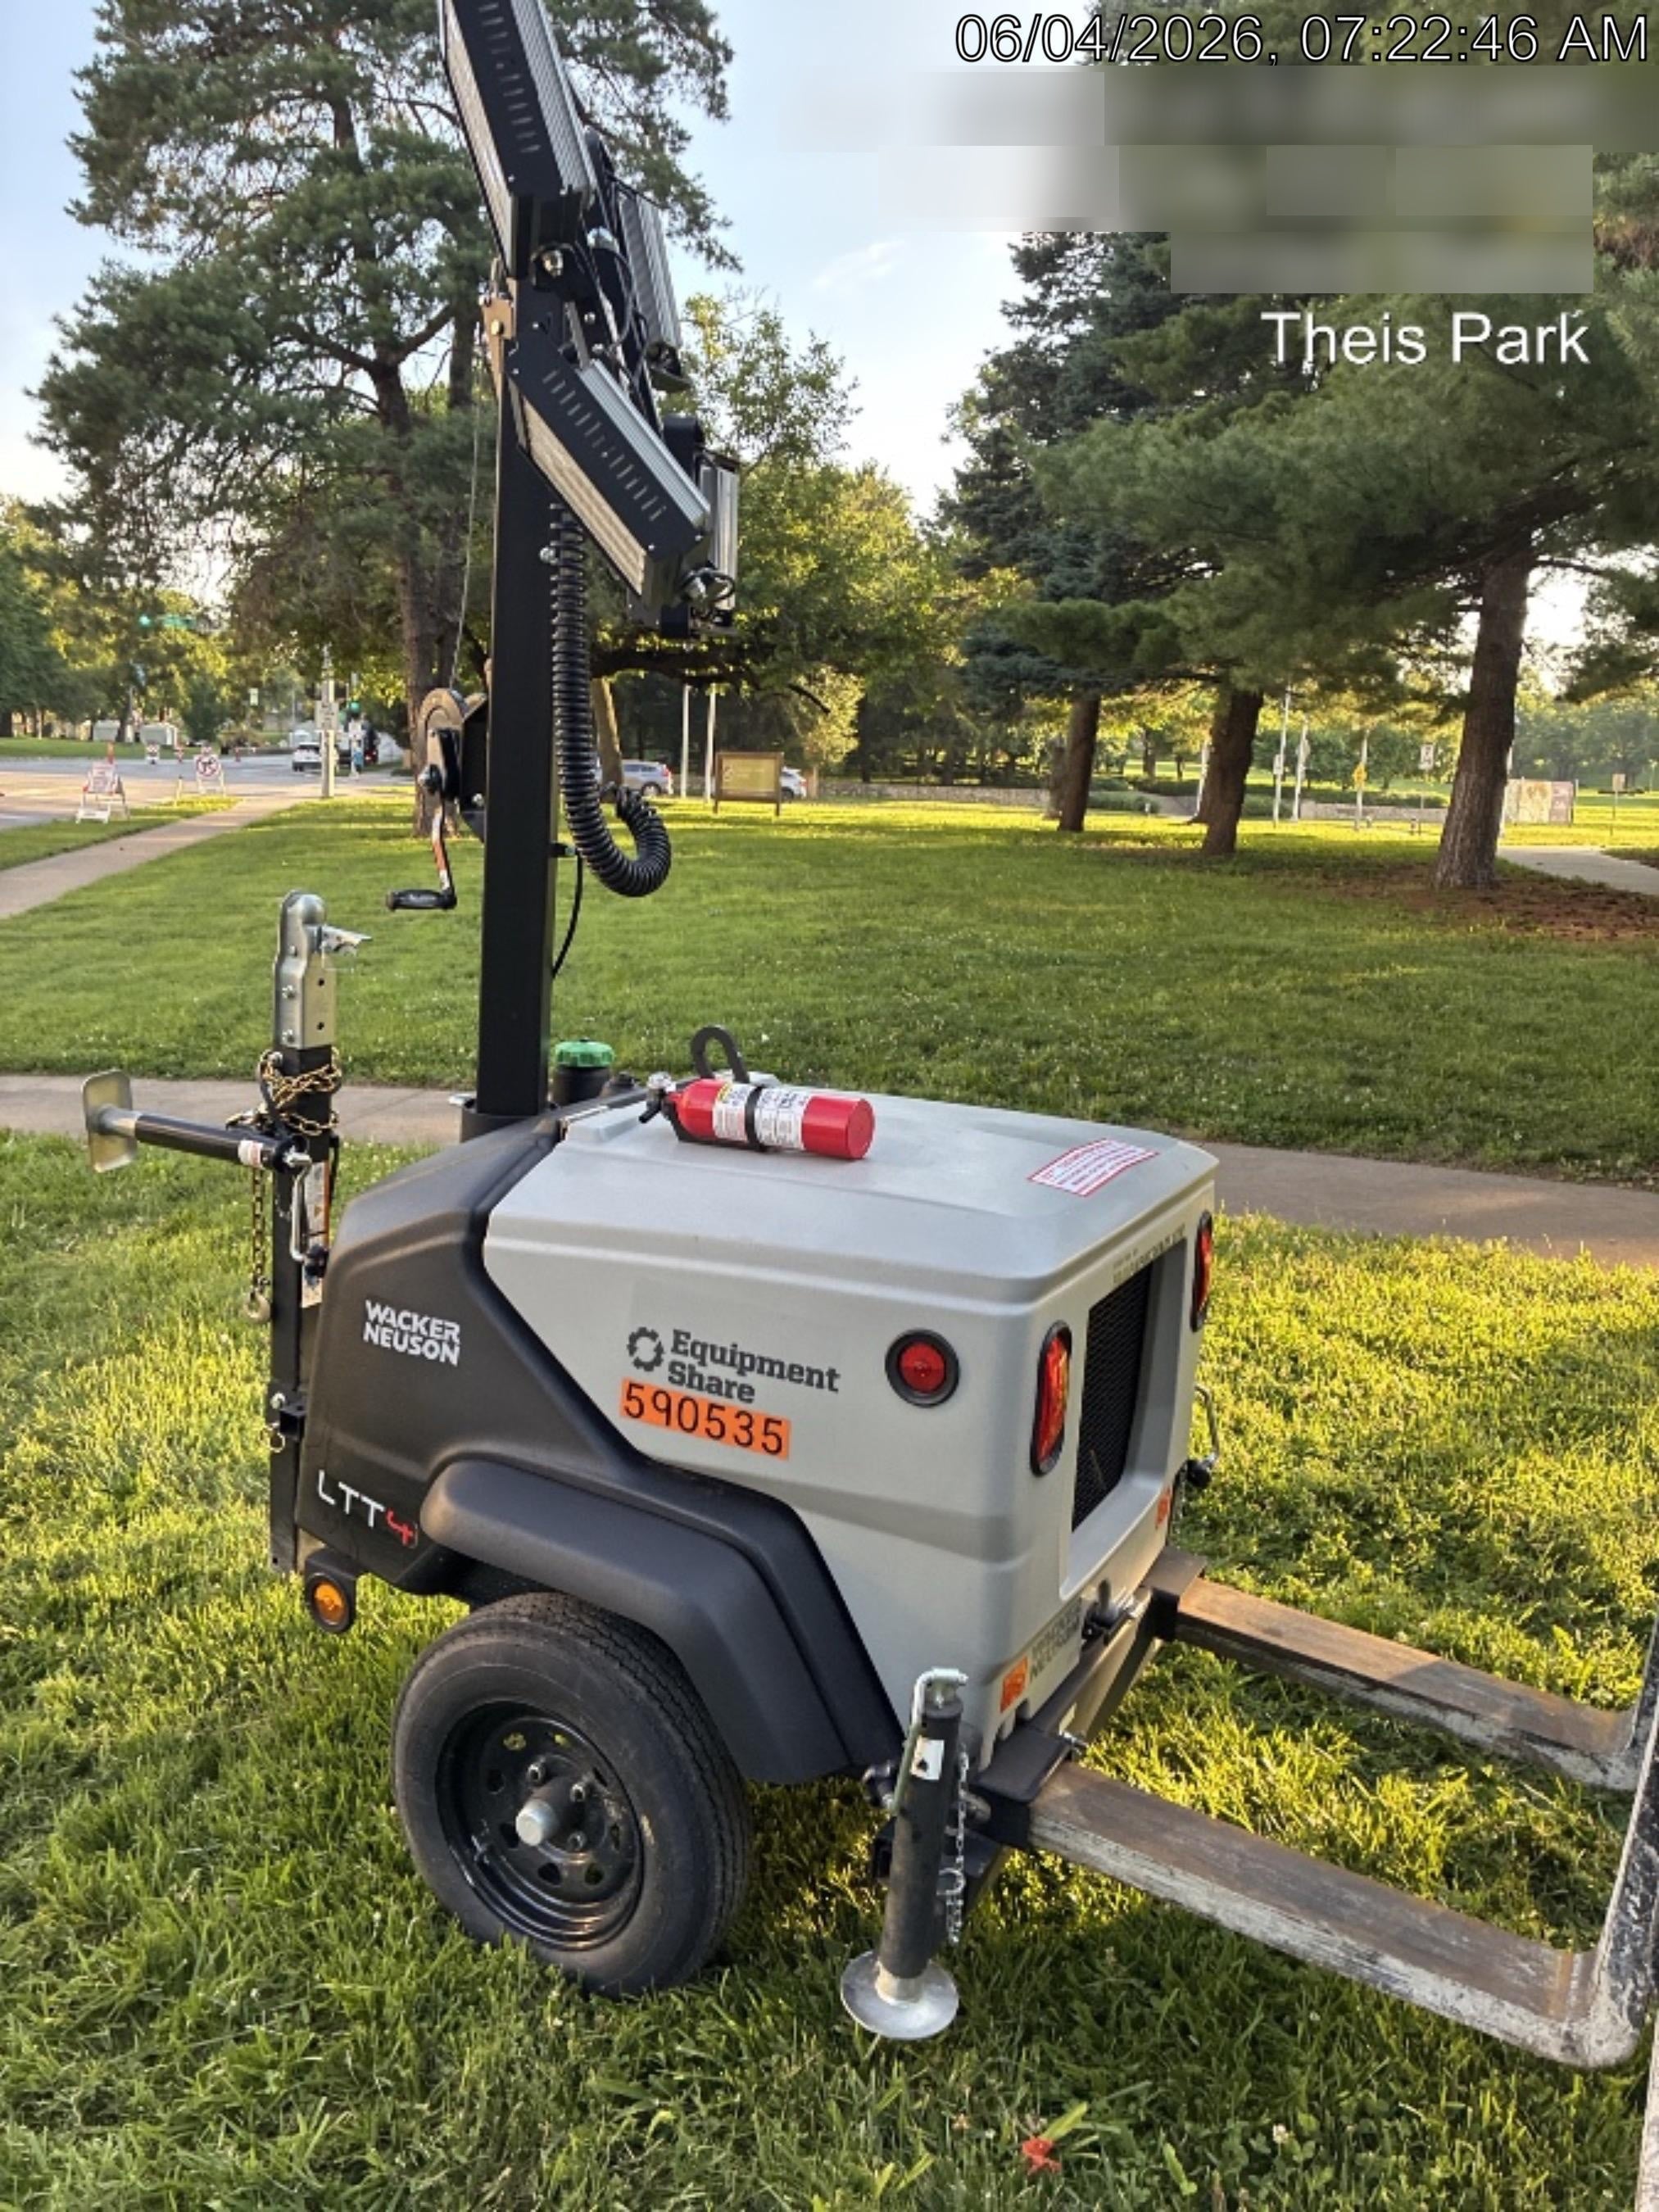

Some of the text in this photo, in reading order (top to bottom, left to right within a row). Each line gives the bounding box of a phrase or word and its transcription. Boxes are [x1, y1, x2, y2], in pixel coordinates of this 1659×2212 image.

[363, 1321, 460, 1367] NEUSON
[365, 1299, 460, 1343] WACKER
[668, 1360, 755, 1403] Share
[670, 1328, 841, 1393] Equipment
[624, 1382, 783, 1455] 590535
[318, 1470, 415, 1546] LTT4
